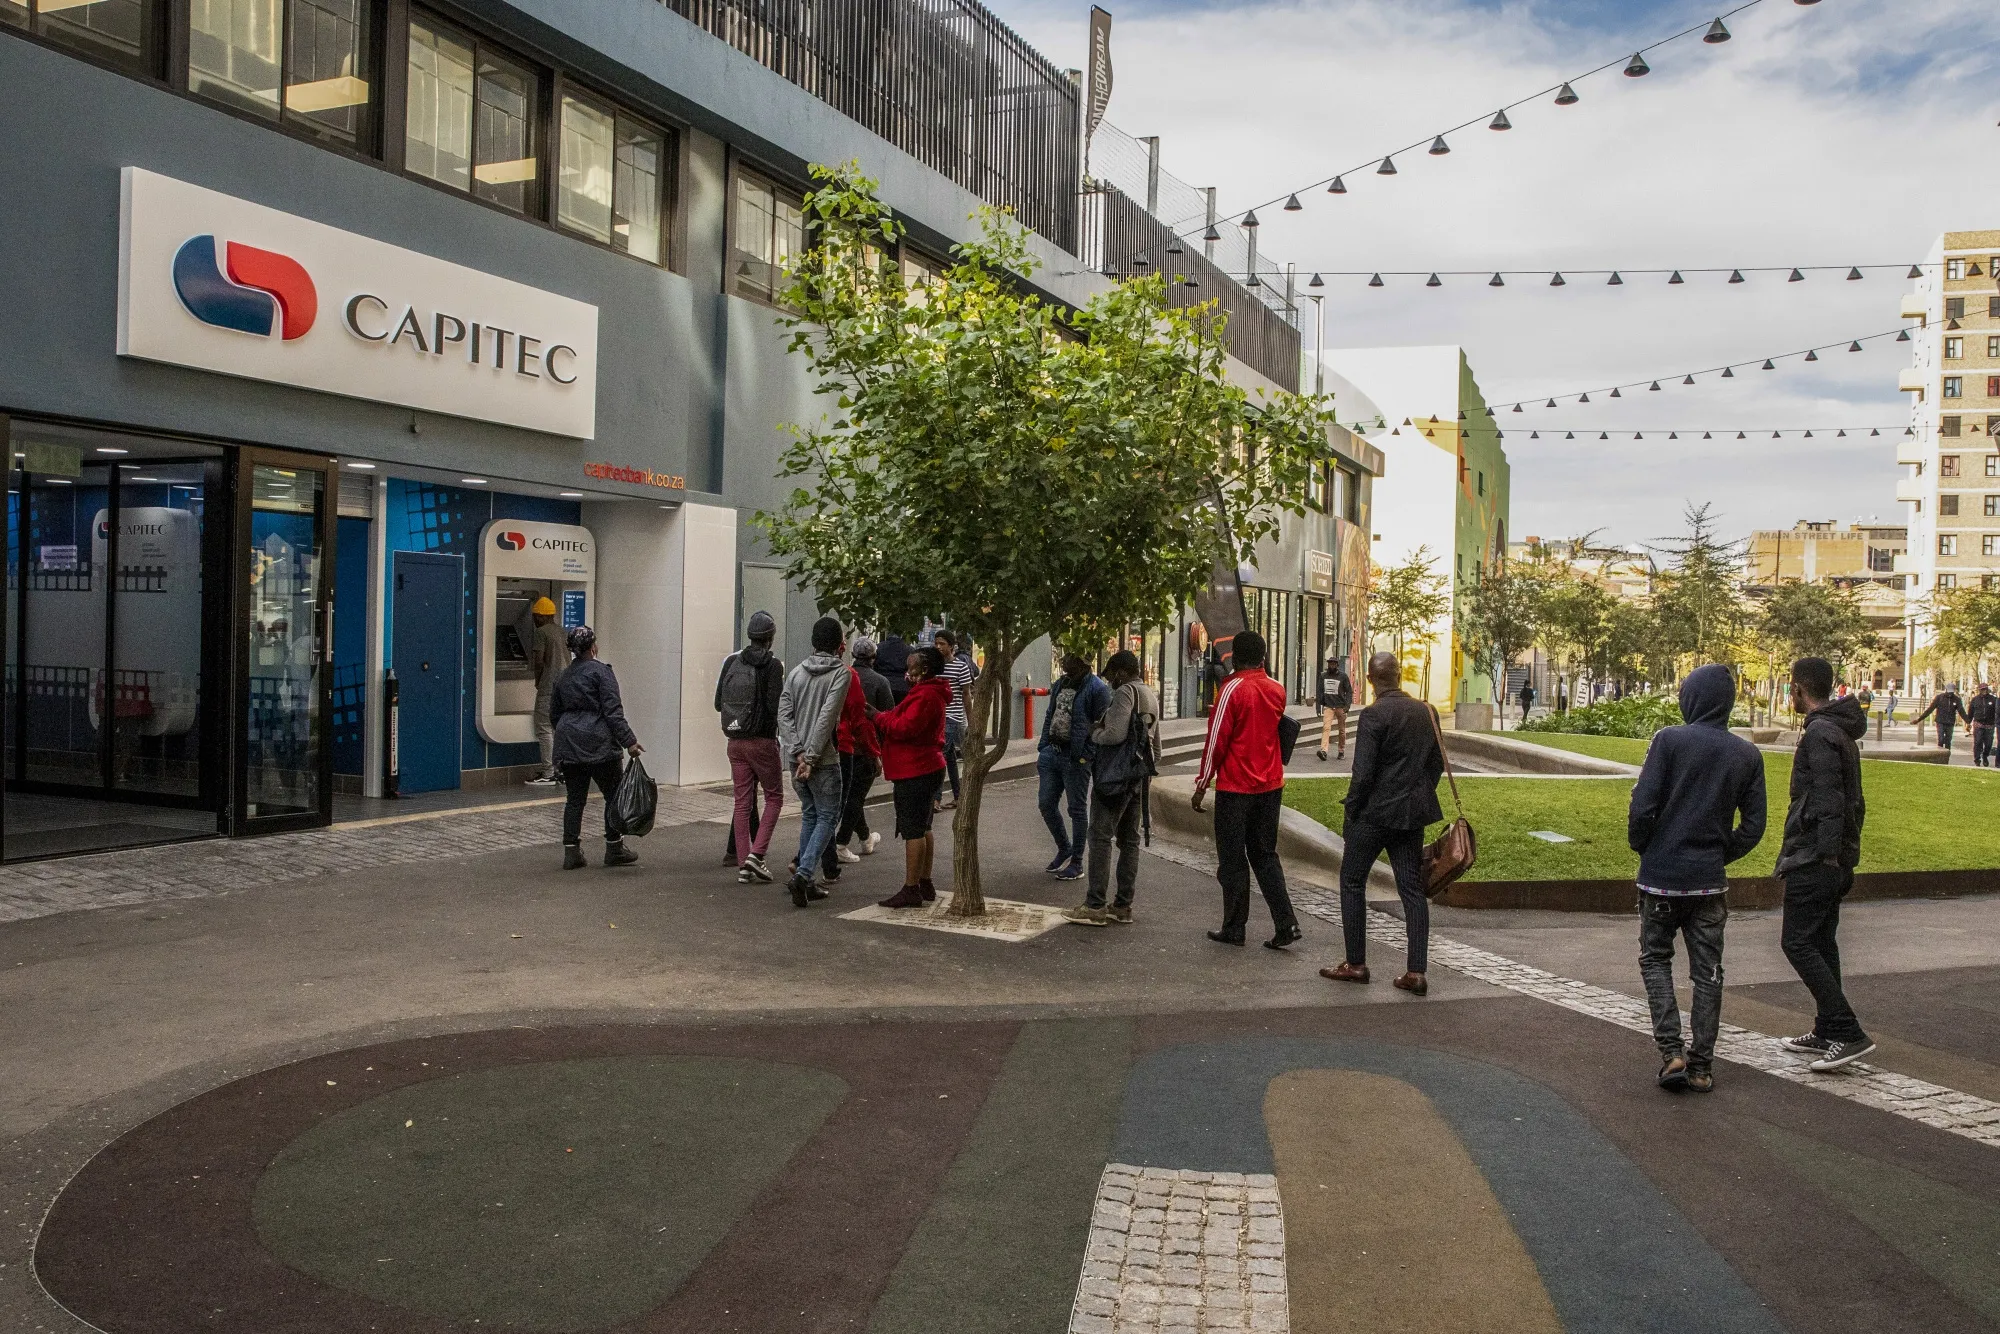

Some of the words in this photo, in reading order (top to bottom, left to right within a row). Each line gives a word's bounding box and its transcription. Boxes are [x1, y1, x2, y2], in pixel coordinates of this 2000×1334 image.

[1091, 26, 1108, 132] ONTHEDREAM
[344, 292, 579, 386] CAPITEC
[583, 461, 685, 490] capitecbank.co.za
[532, 538, 589, 553] CAPITEC
